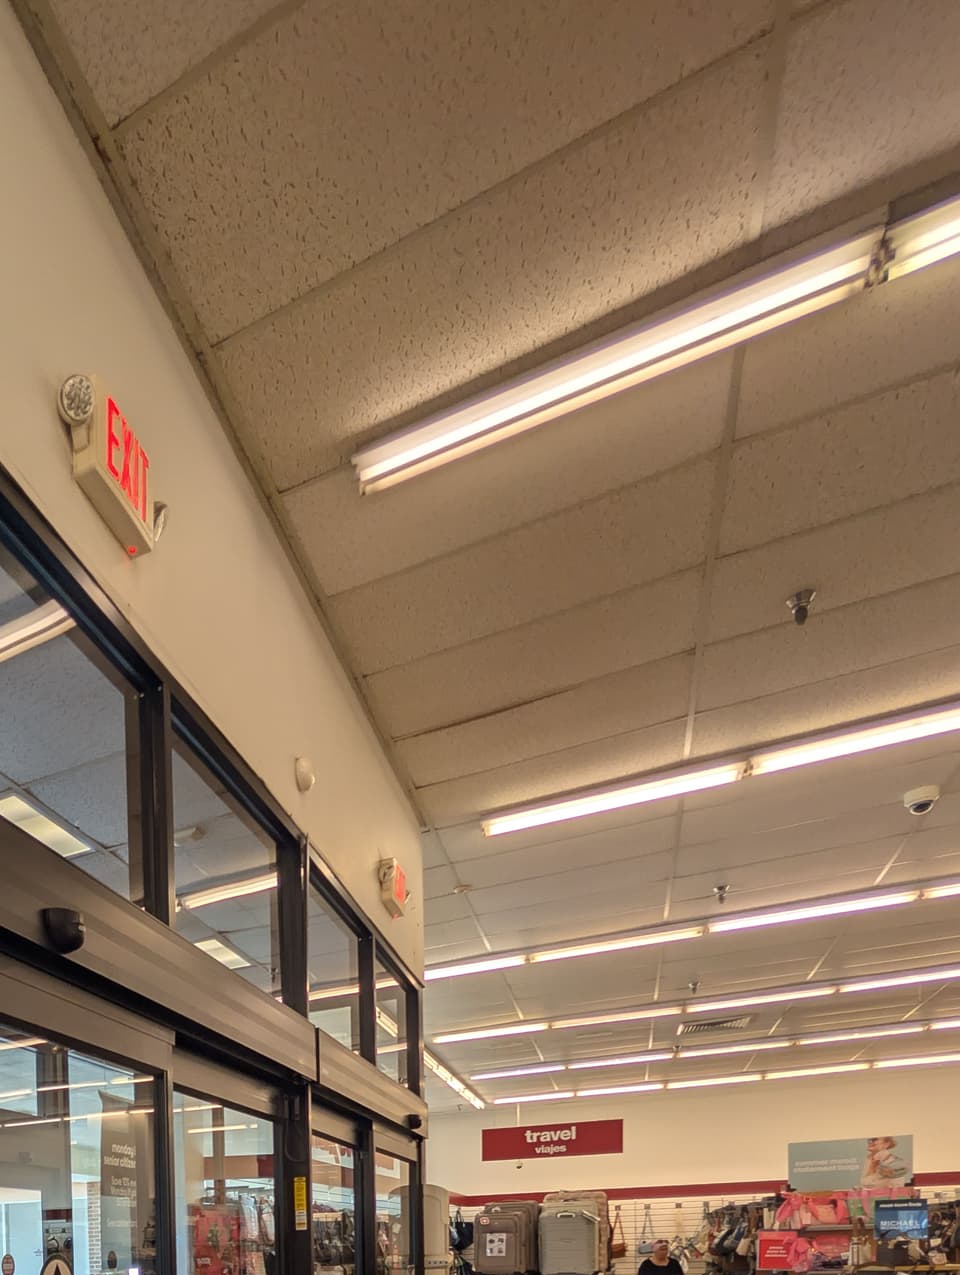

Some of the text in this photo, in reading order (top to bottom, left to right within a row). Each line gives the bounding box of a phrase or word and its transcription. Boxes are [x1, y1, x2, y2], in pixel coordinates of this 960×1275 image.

[106, 396, 149, 523] EXIT
[524, 1126, 577, 1143] travel
[535, 1144, 567, 1155] viajes
[879, 1219, 920, 1228] MICHAEL
